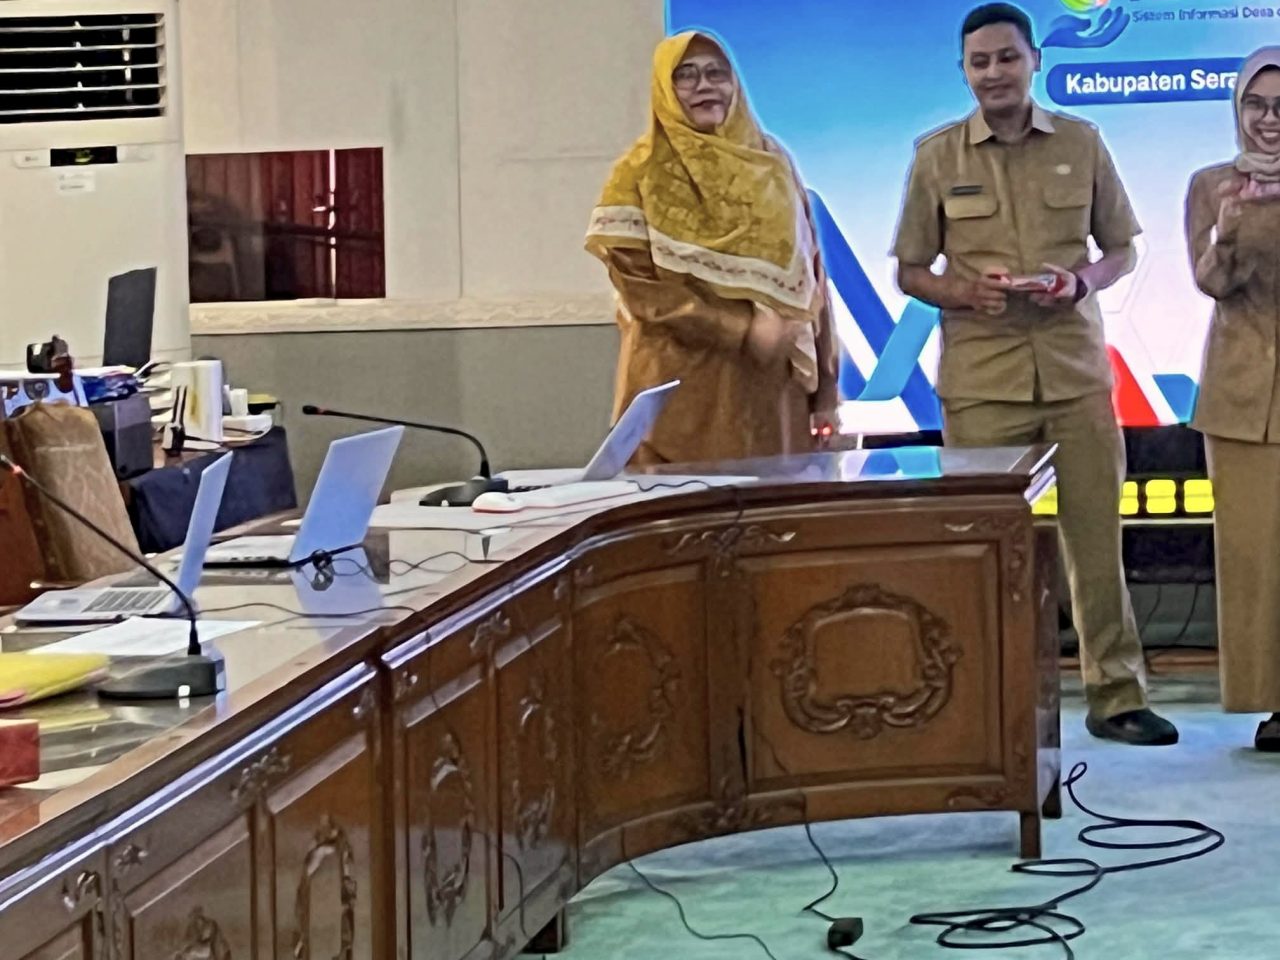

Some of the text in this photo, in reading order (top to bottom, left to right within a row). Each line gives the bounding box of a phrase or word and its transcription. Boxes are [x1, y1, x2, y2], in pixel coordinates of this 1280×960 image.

[1178, 5, 1240, 21] Informasi
[1065, 71, 1186, 97] Kabupaten
[1190, 68, 1239, 91] Sera
